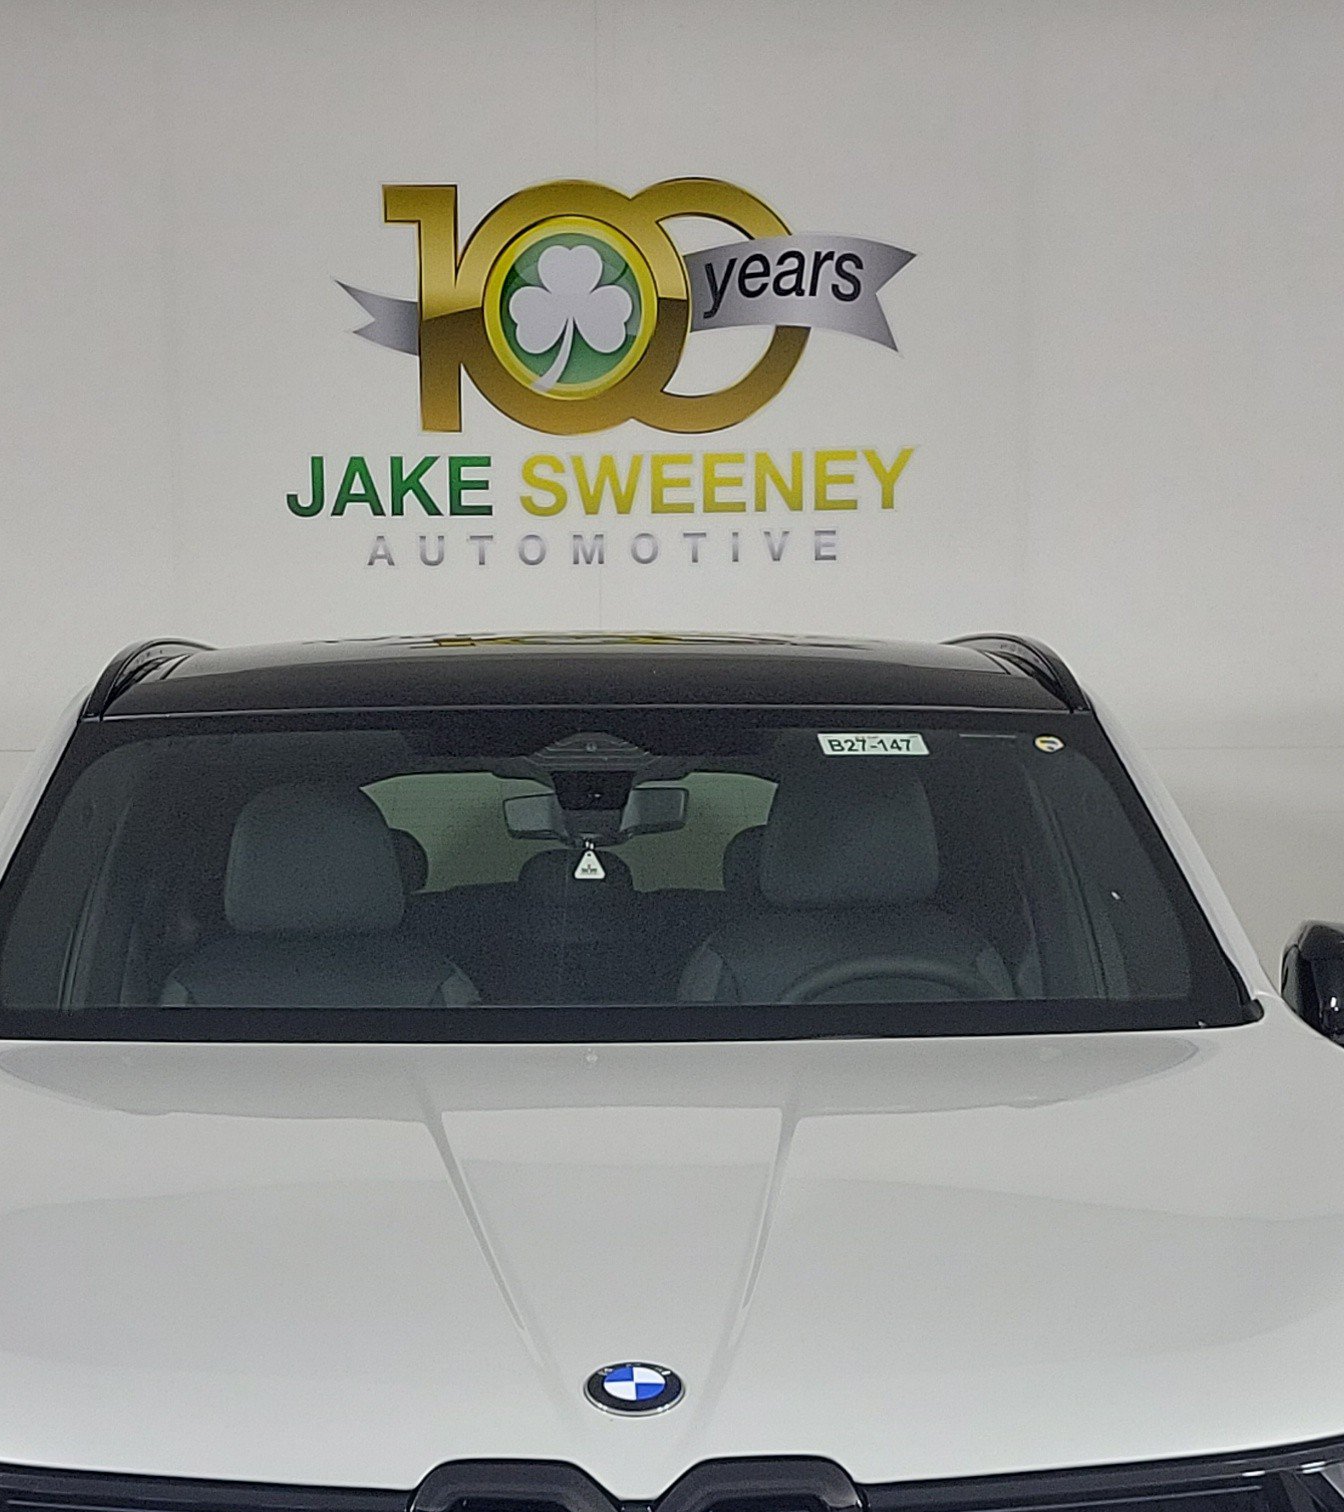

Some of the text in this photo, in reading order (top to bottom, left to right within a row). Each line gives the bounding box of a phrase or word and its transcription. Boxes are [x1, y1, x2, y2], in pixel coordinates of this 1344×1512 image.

[382, 177, 864, 435] 100 years
[286, 446, 915, 518] JAKE SWEENEY
[366, 529, 838, 567] AUTOMOTIVE
[827, 738, 911, 752] B27-147
